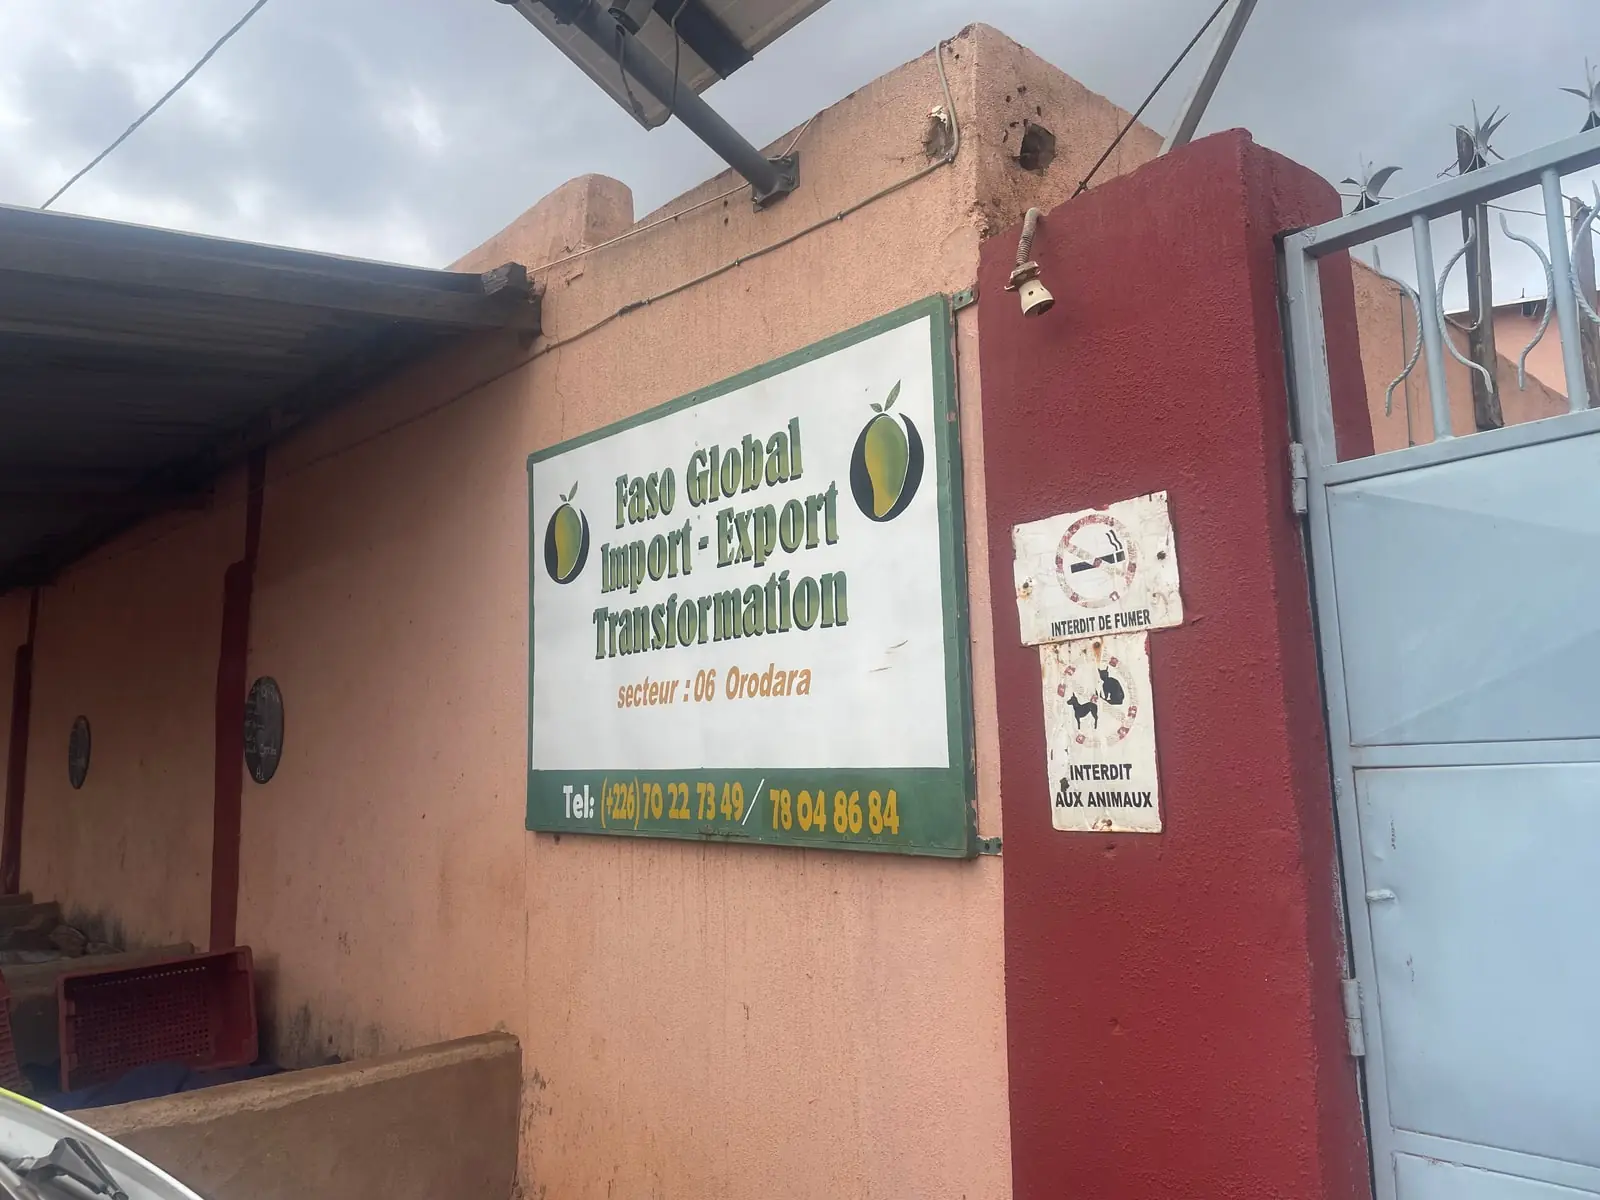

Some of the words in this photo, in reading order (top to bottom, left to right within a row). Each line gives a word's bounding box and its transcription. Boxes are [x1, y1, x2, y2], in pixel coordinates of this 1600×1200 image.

[615, 466, 676, 529] Faso
[686, 417, 803, 507] Global
[601, 518, 692, 594] Import
[717, 480, 839, 568] Export
[593, 570, 849, 660] Transformation
[1051, 617, 1095, 637] INTERDIT
[1098, 614, 1112, 631] DE
[1114, 609, 1151, 629] FUMER
[617, 676, 679, 708] secteur
[726, 663, 812, 699] Orodara
[1070, 763, 1132, 781] INTERDIT
[563, 784, 595, 819] Tel:
[668, 782, 691, 820] 22
[697, 782, 715, 820] 73
[720, 782, 744, 821] 49
[770, 789, 791, 830] 78
[797, 789, 826, 832] 04
[833, 790, 862, 834] 86
[868, 790, 900, 834] 84
[1056, 791, 1084, 808] AUX
[1087, 791, 1153, 808] ANIMAUX
